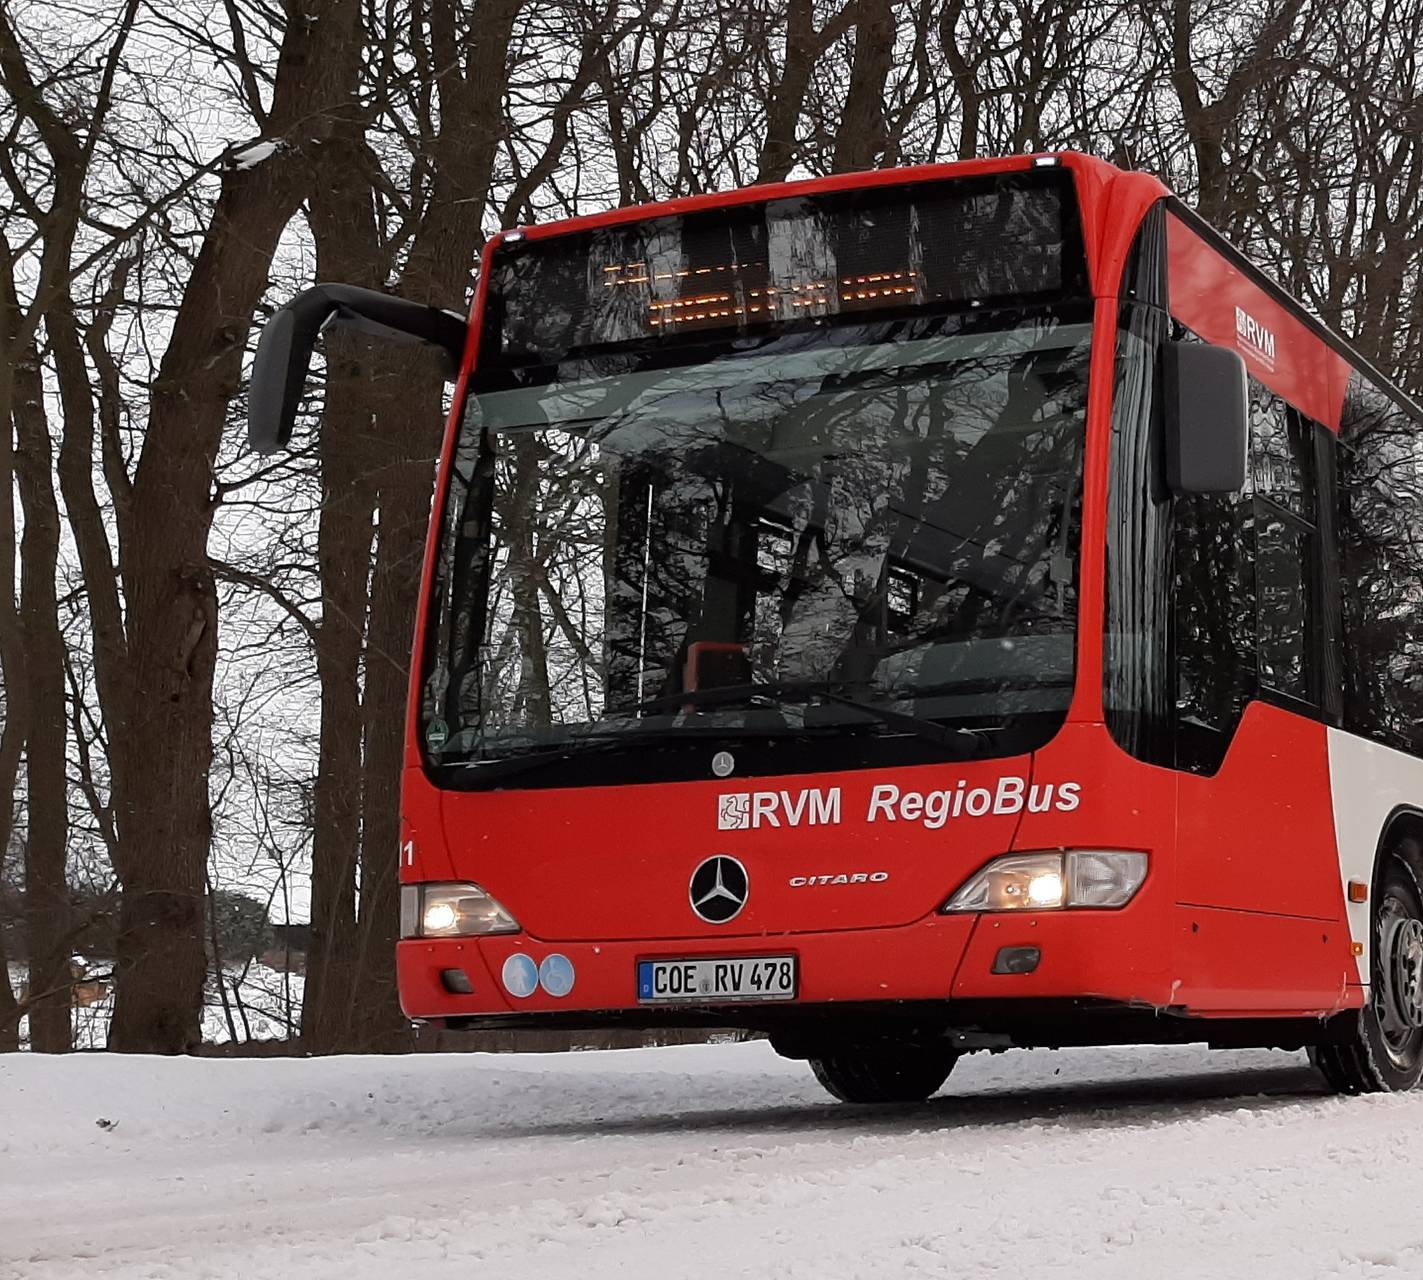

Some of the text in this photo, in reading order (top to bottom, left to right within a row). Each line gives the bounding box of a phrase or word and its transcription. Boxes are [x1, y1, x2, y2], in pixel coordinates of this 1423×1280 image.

[1246, 314, 1275, 359] RVM
[752, 776, 1082, 829] RVM RegioBus
[789, 872, 889, 887] CITARO
[655, 965, 697, 994] COE
[715, 963, 743, 992] RV
[750, 962, 792, 991] 478
